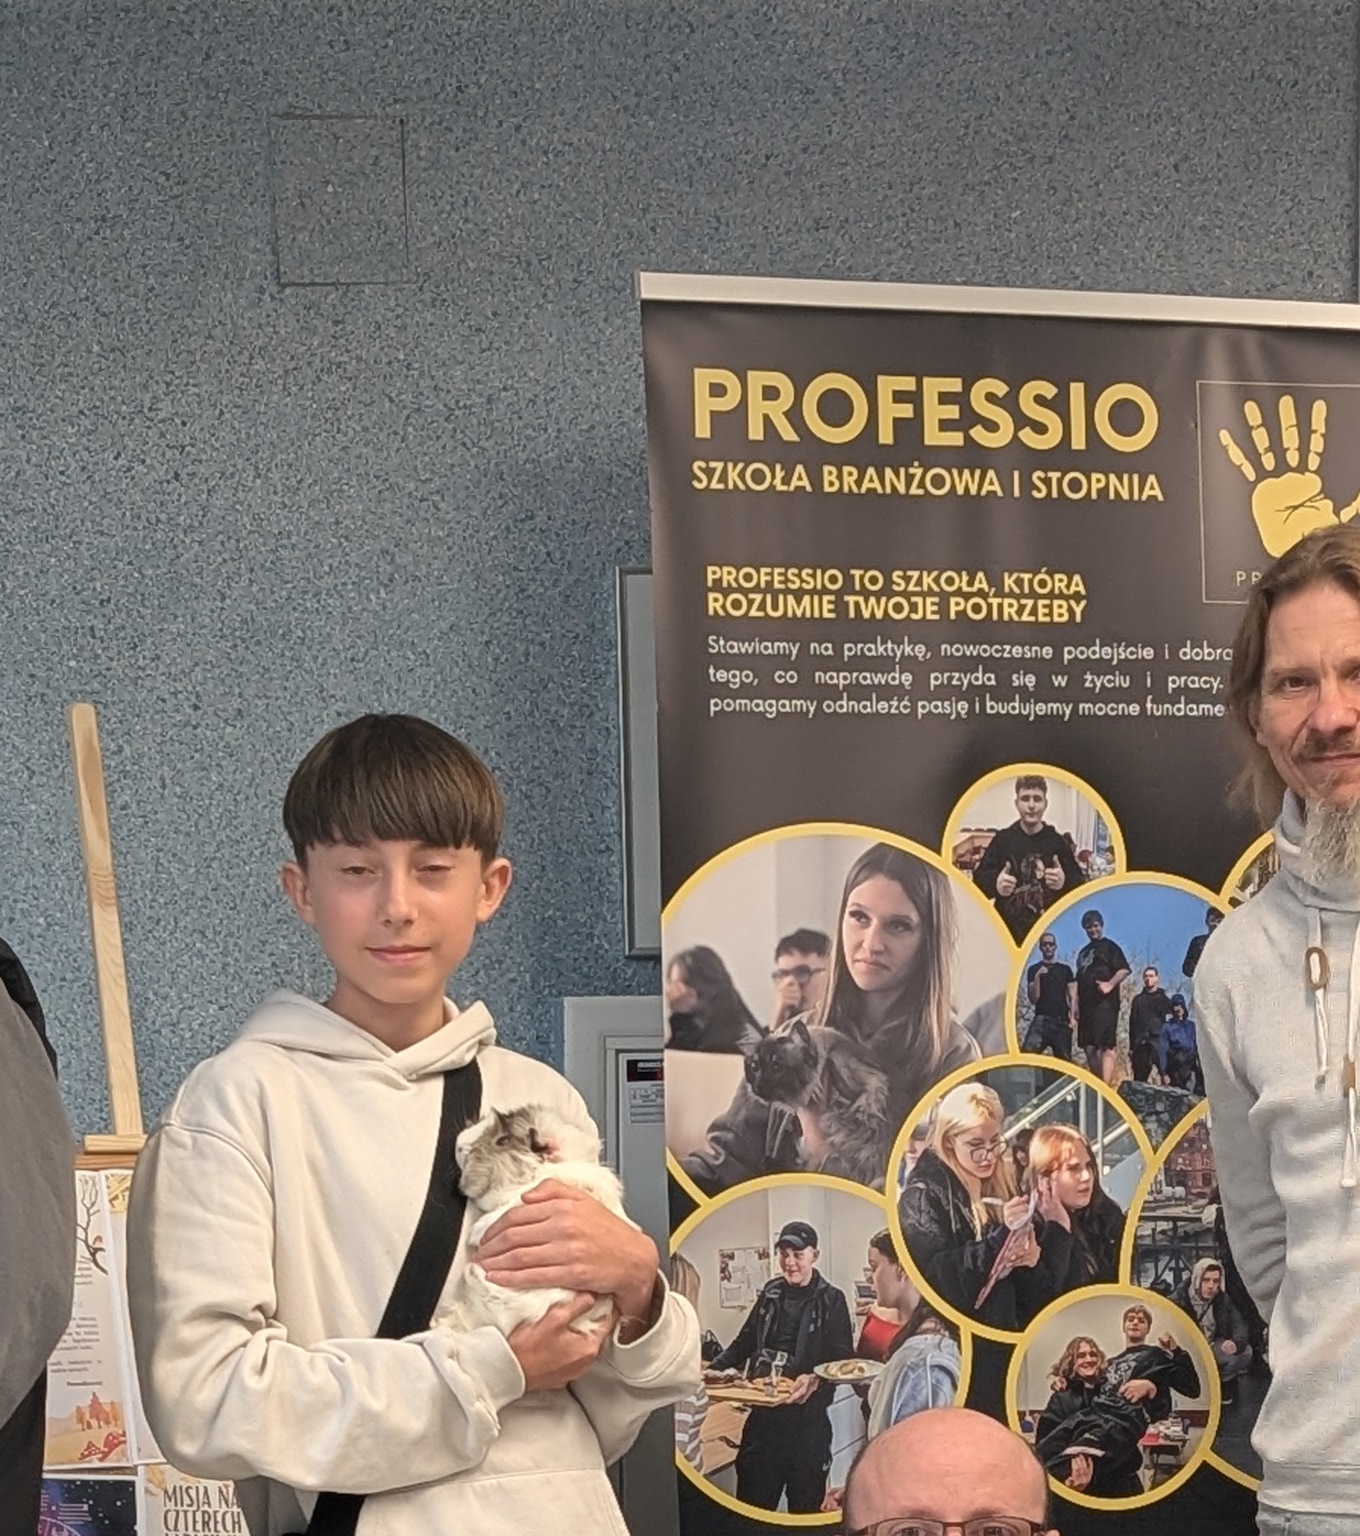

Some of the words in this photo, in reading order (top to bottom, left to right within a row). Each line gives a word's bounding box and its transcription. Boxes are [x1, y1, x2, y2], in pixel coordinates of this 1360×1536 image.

[693, 367, 1159, 453] PROFESSIO
[691, 460, 813, 492] SZKOŁA
[822, 461, 1004, 497] BRANŻOWA
[1013, 470, 1021, 498] I
[1031, 470, 1165, 502] STOPNIA
[706, 565, 843, 590] PROFESSIO
[849, 569, 884, 591] TO
[891, 570, 997, 597] SZKOŁA,
[1003, 567, 1087, 596] KTÓRA
[707, 592, 837, 619] ROZUMIE
[843, 595, 941, 620] TWOJE
[949, 597, 1088, 623] POTRZEBY
[707, 635, 800, 661] Stawiamy
[810, 640, 834, 656] na
[843, 635, 932, 662] praktykę,
[940, 642, 1053, 659] nowoczesne
[1063, 638, 1154, 665] podejście
[1164, 640, 1170, 660] i
[708, 664, 759, 689] tego,
[774, 670, 798, 684] co
[814, 664, 913, 690] naprawdę
[930, 665, 997, 691] przyda
[1011, 668, 1036, 691] się
[1051, 674, 1068, 687] w
[1083, 670, 1130, 693] życiu
[1146, 671, 1152, 688] i
[1168, 675, 1225, 695] pracy.
[709, 697, 817, 719] pomagamy
[822, 692, 911, 714] odnaleźć
[917, 696, 969, 720] pasję
[975, 696, 980, 714] i
[985, 694, 1073, 721] budujemy
[1078, 700, 1140, 717] mocne
[163, 1484, 212, 1511] MISJA
[163, 1509, 242, 1534] CZTERECH
